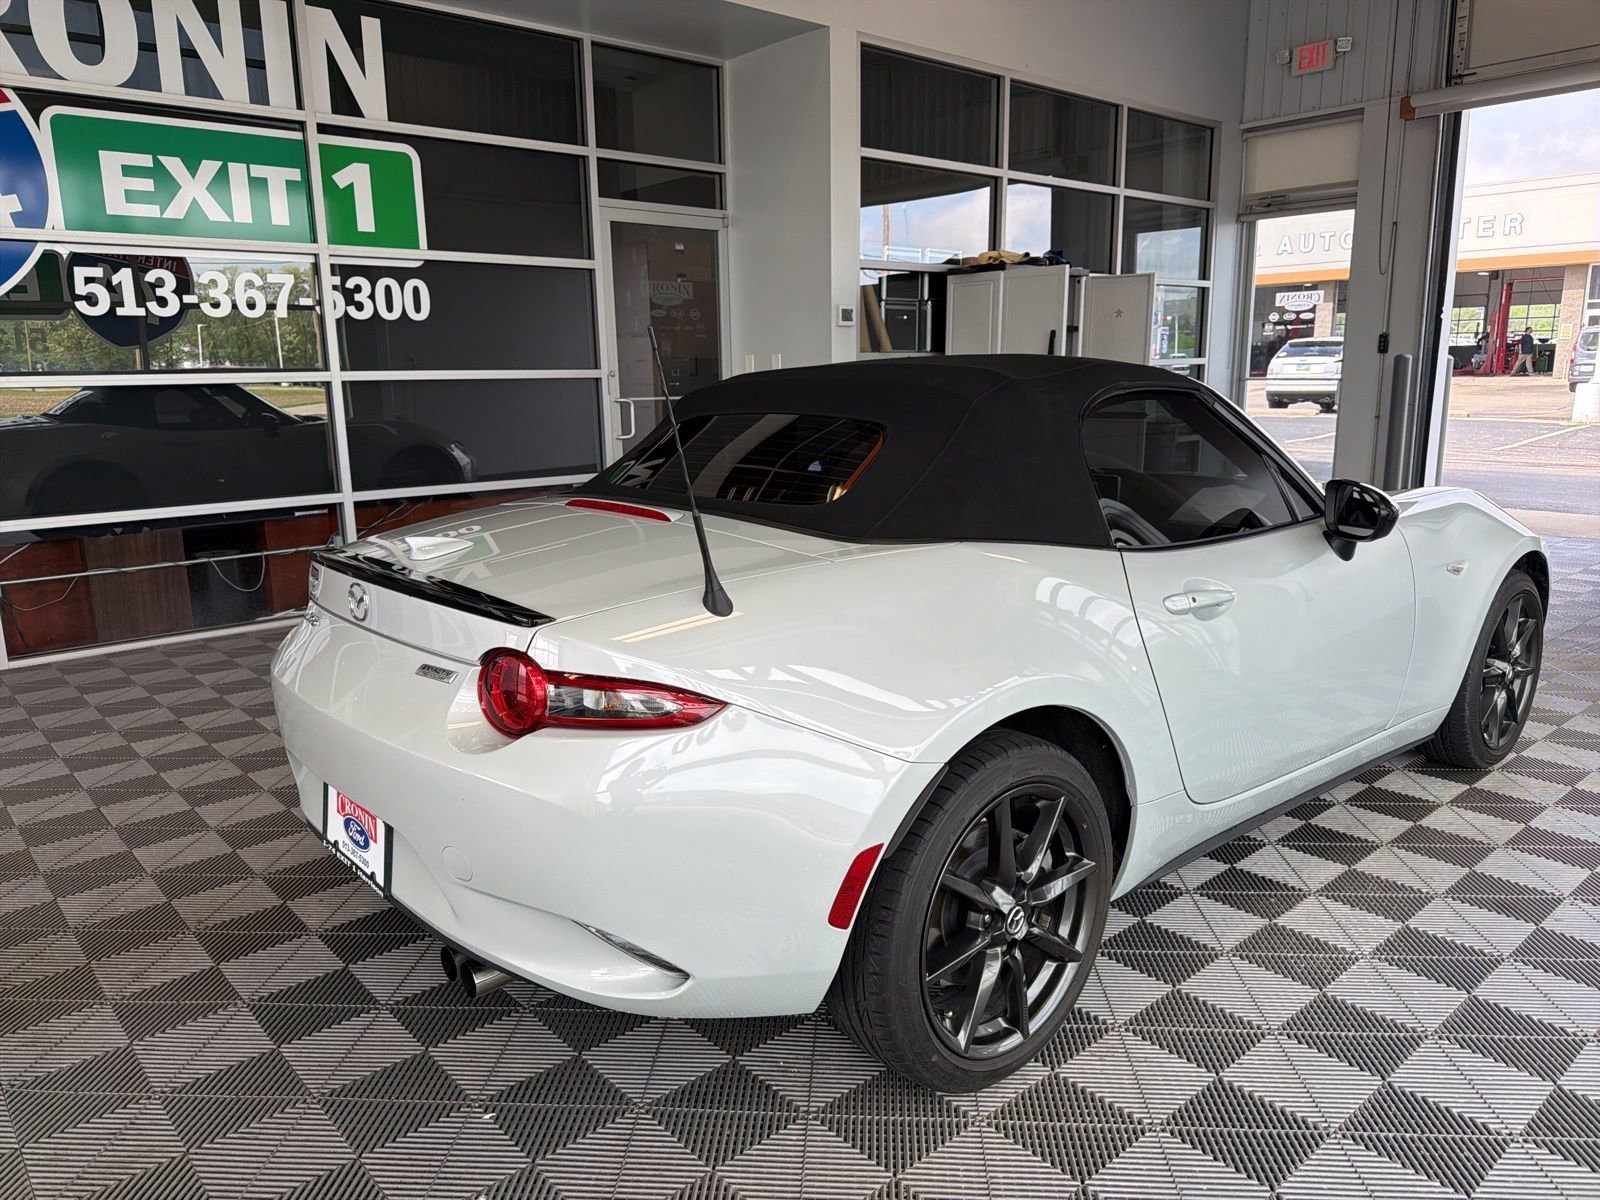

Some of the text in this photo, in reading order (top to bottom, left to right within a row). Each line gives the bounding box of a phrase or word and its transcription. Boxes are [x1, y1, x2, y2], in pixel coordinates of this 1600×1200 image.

[1298, 42, 1328, 70] EXIT
[98, 150, 301, 226] EXIT
[331, 162, 376, 233] 1
[1276, 228, 1353, 256] AUTO
[73, 266, 430, 322] 513-367-5300
[650, 281, 691, 298] RONIN
[338, 793, 376, 843] CRONIN
[348, 820, 365, 846] Ford
